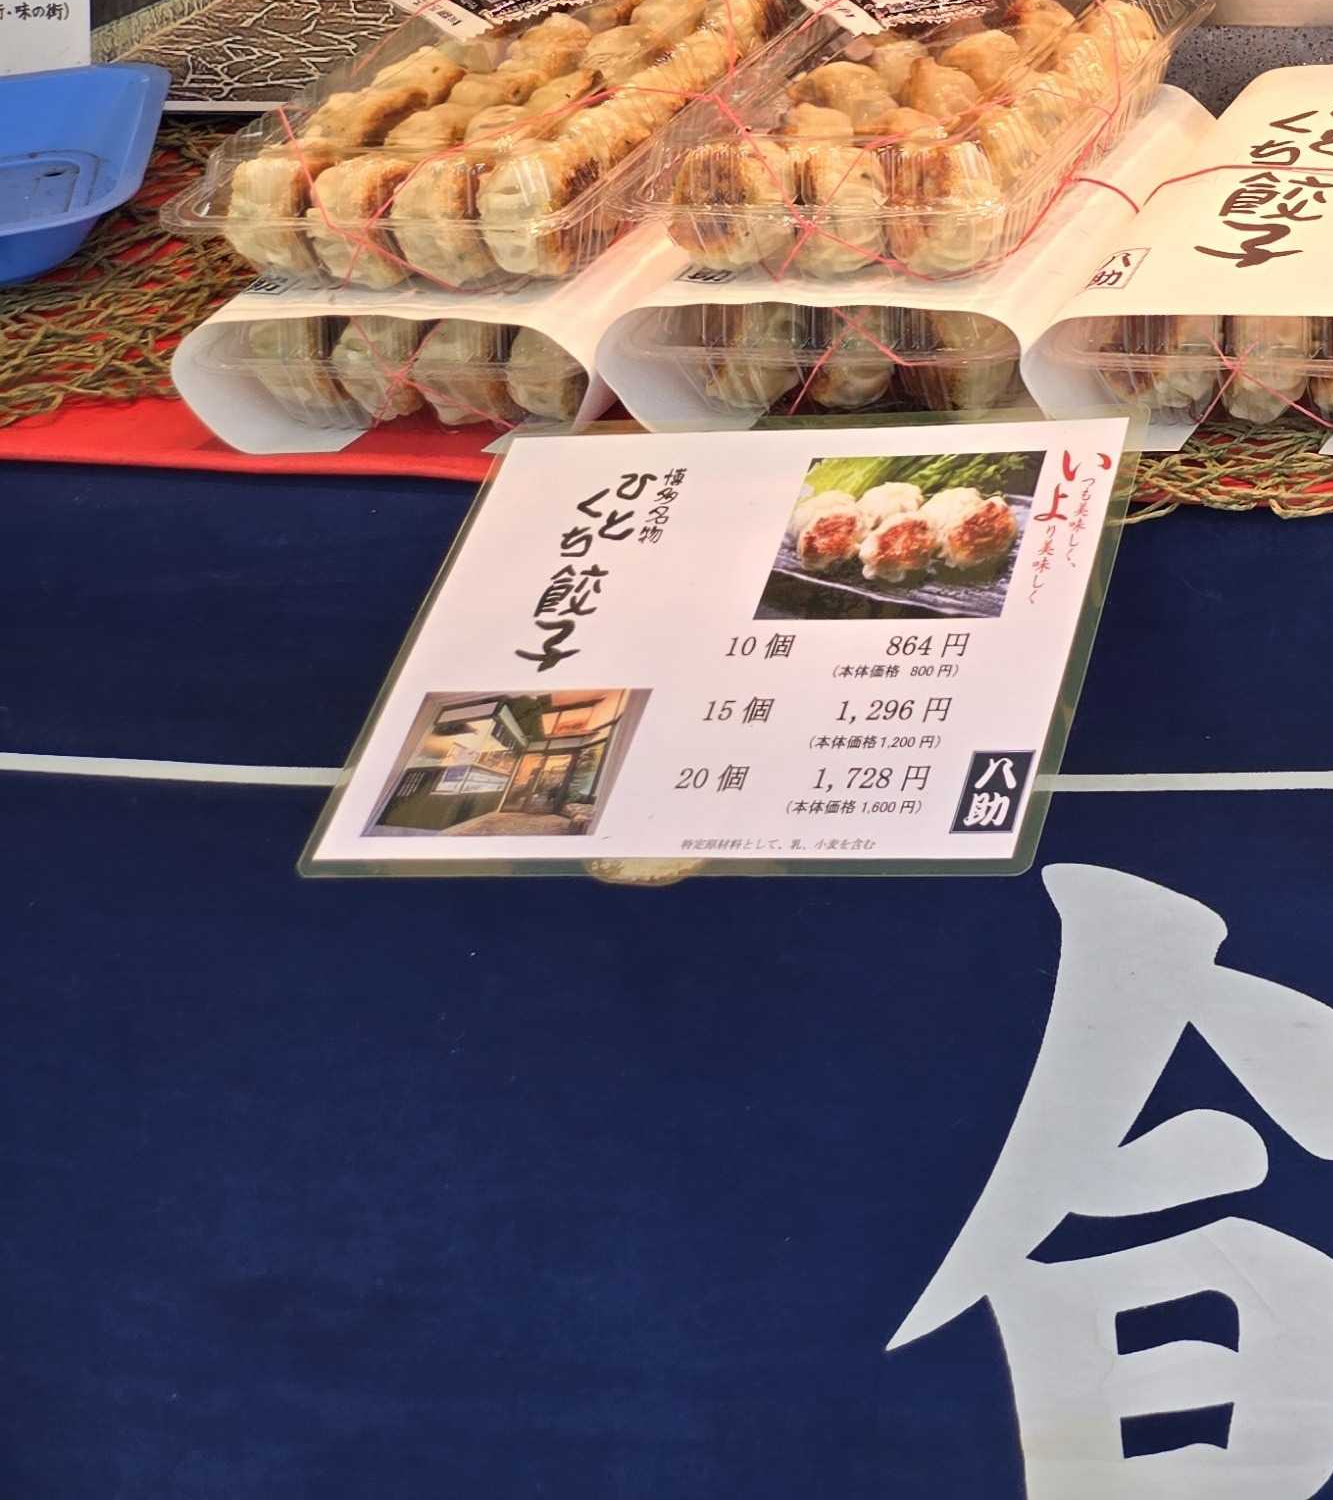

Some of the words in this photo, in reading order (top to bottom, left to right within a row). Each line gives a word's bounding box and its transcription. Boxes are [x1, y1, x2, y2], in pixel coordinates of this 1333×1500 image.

[1093, 252, 1131, 287] 八助
[638, 467, 688, 544] 博多名物
[514, 472, 658, 673] ひとくち餃子
[963, 756, 1018, 829] 八助
